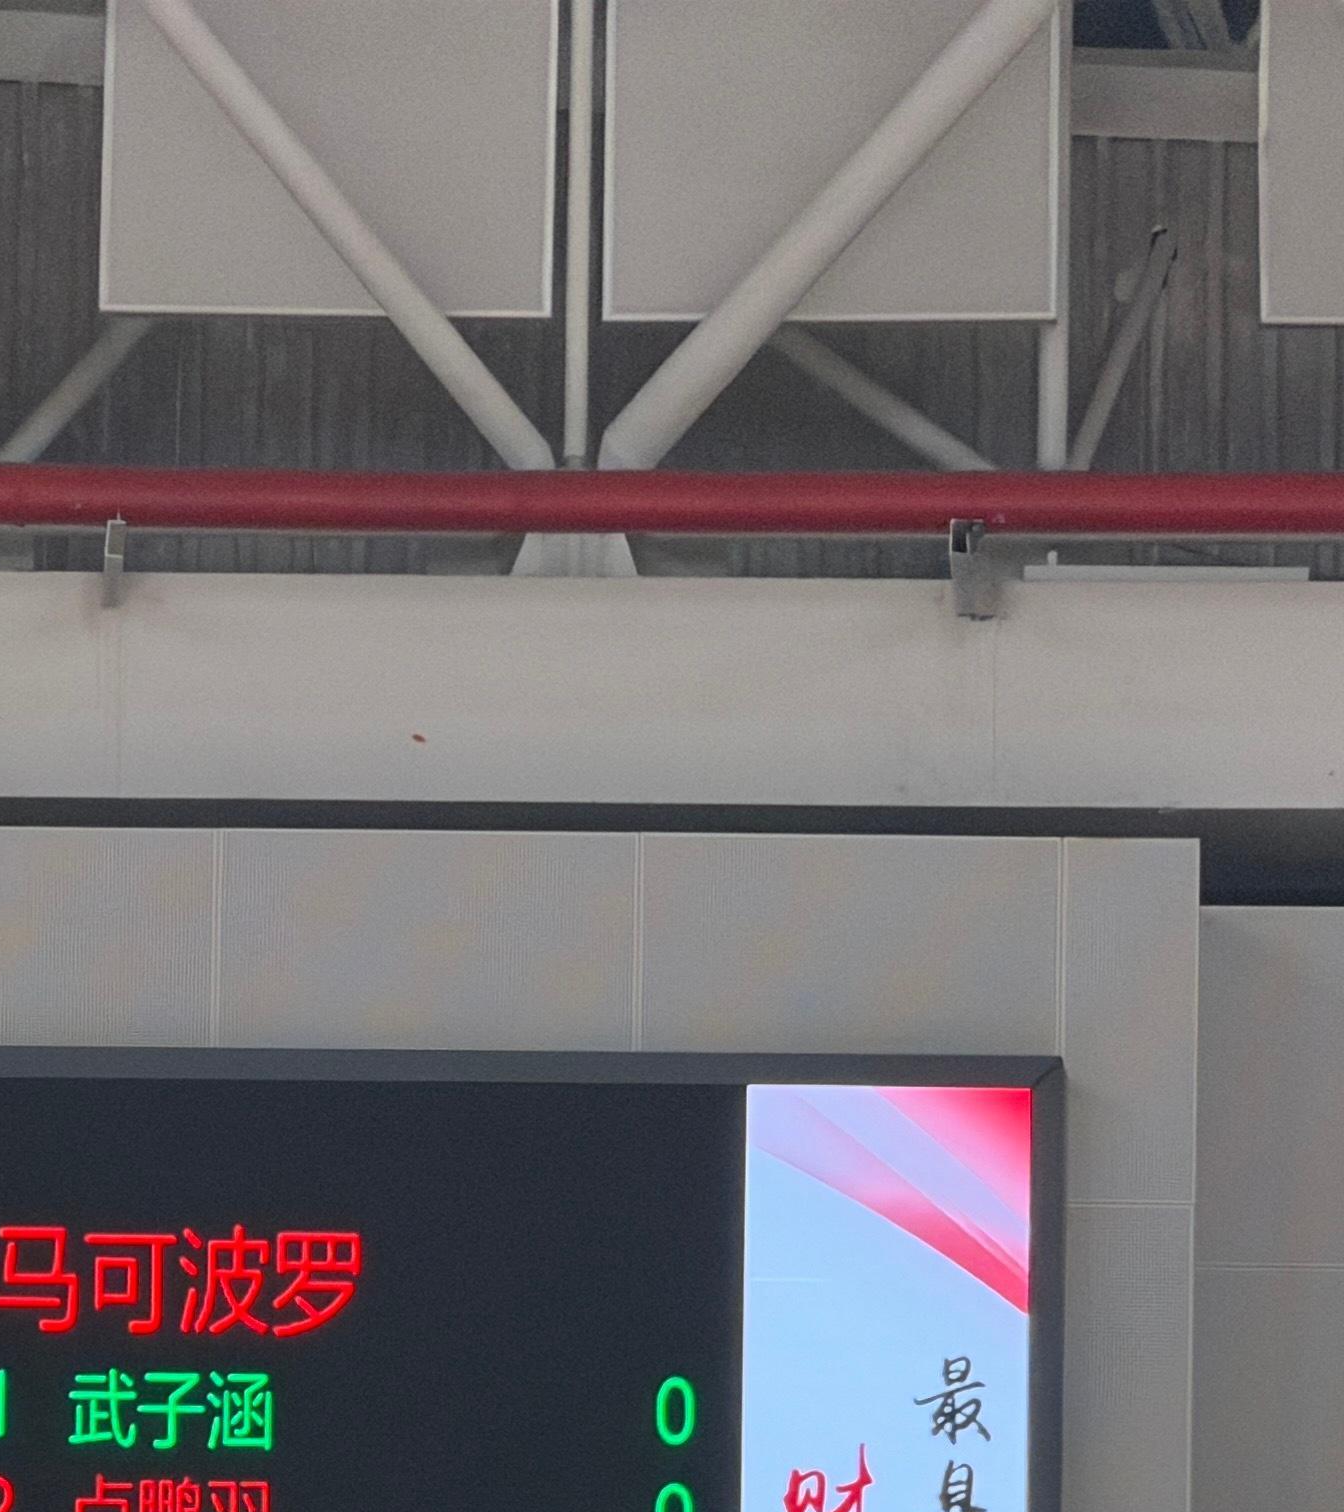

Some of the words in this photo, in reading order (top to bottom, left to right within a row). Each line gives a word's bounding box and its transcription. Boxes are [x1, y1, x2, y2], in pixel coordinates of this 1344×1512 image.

[66, 1366, 274, 1452] 武子涵
[654, 1375, 697, 1447] 0
